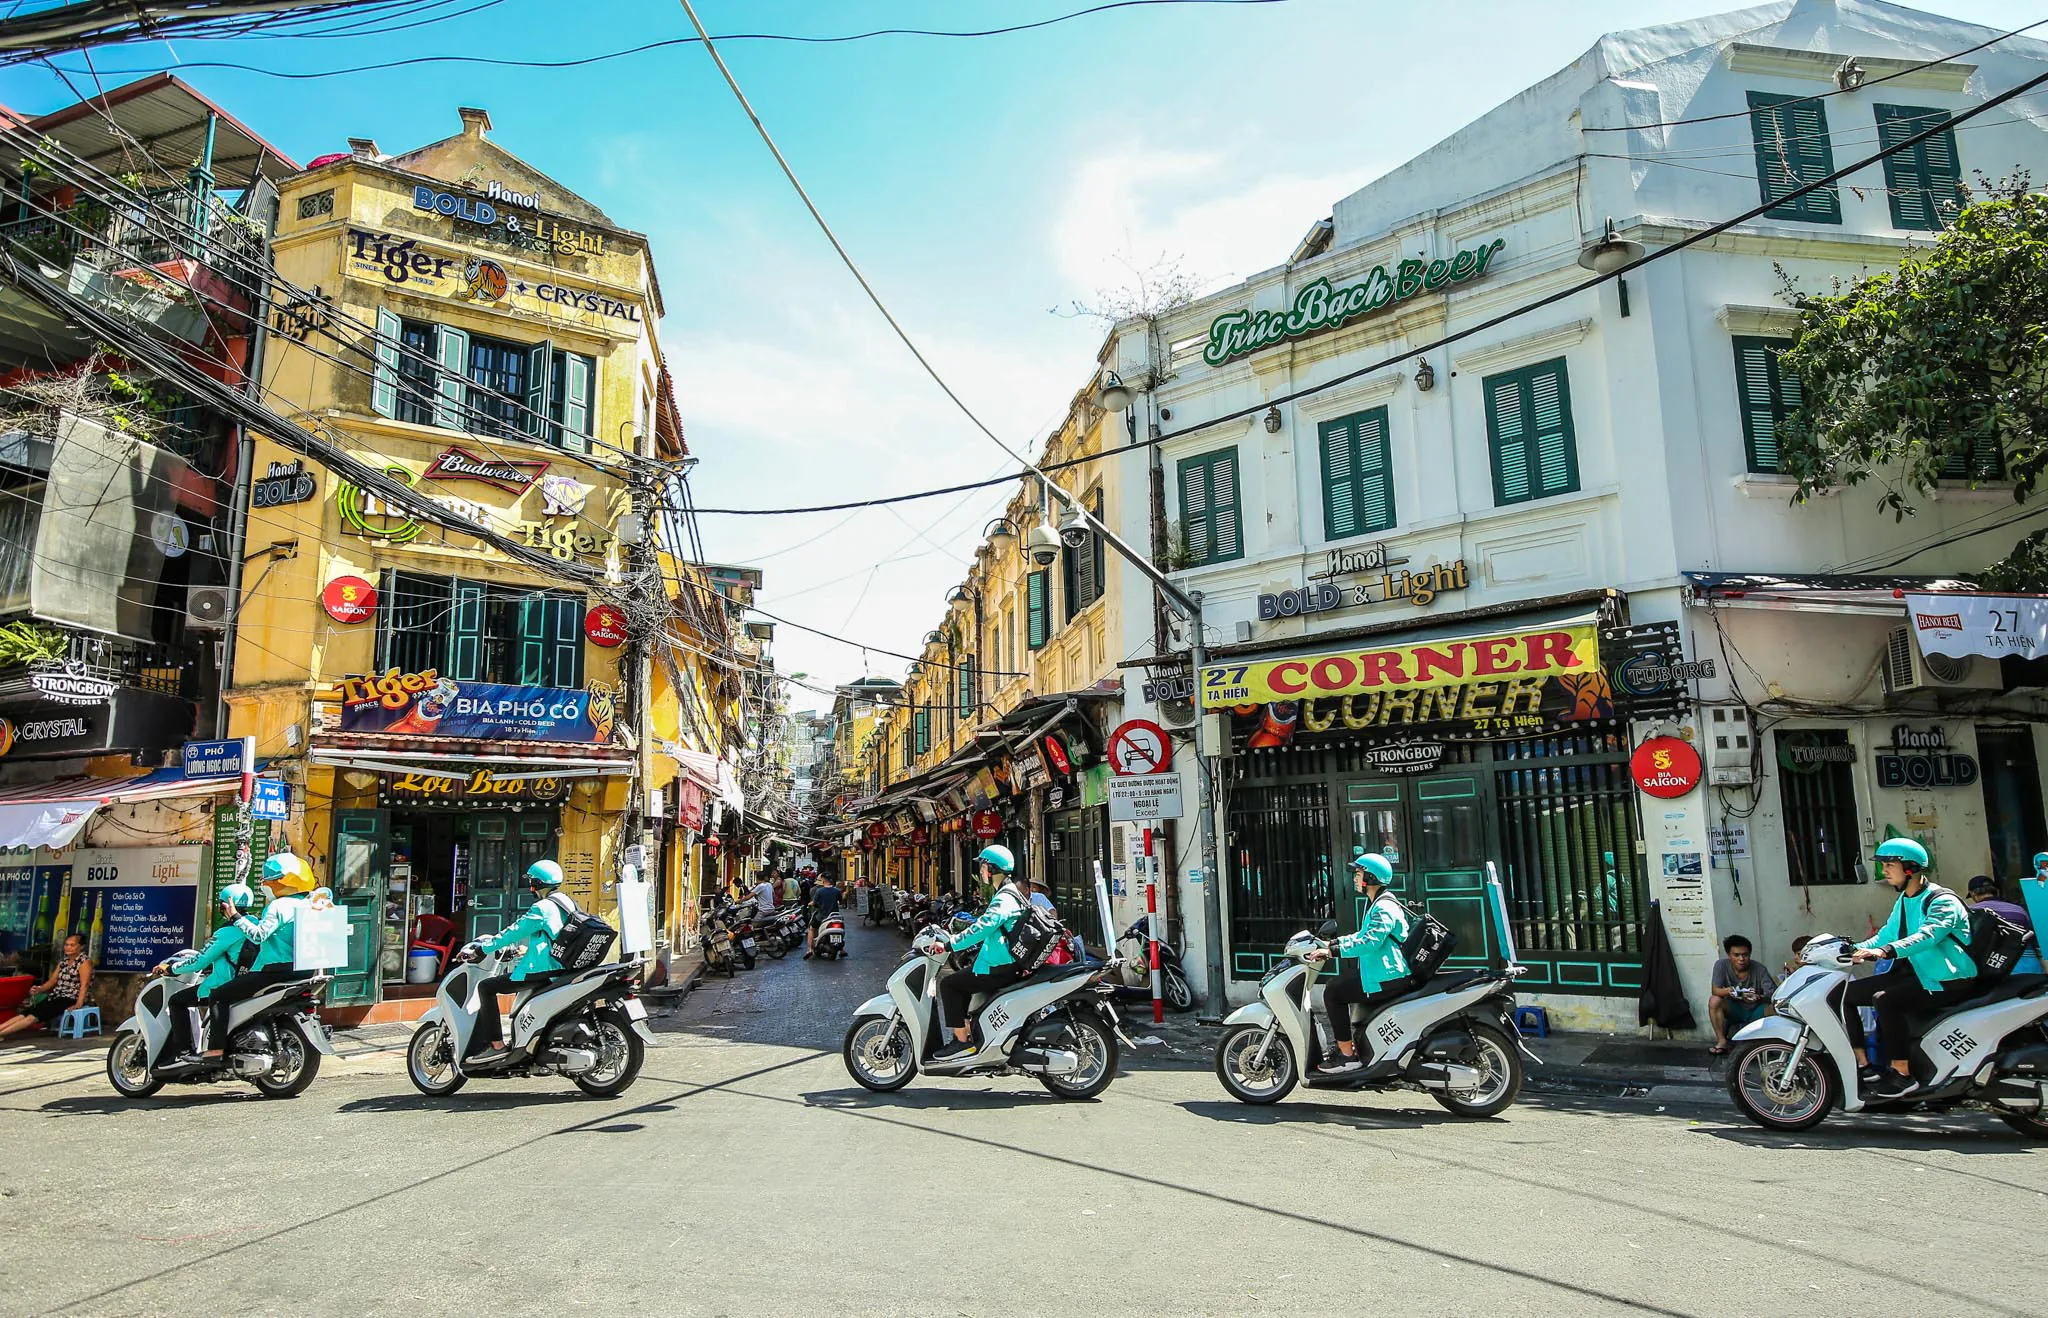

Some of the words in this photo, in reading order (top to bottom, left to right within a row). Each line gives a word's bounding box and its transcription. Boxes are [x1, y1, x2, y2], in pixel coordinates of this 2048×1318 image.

[487, 180, 541, 211] Hanoi
[413, 185, 498, 226] BOLD
[506, 214, 523, 234] &
[536, 217, 605, 257] Light
[349, 228, 453, 283] Tiger
[354, 261, 379, 273] SINCE
[1395, 238, 1506, 299] Beer
[535, 283, 642, 324] CRYSTAL
[267, 459, 300, 480] Hanoi
[437, 453, 534, 485] Budweiser
[252, 475, 314, 509] BOLD
[519, 518, 612, 561] Tiger
[1327, 547, 1386, 576] Hanoi
[1257, 583, 1342, 621] BOLD
[1382, 560, 1469, 606] Light
[1918, 614, 1942, 627] HANOI
[1942, 614, 1960, 628] BEER
[1989, 610, 2018, 633] 27
[1155, 664, 1184, 679] Hanoi
[1267, 631, 1583, 695] CORNER
[1628, 659, 1716, 685] TUBORG
[31, 676, 117, 697] STRONGBOW
[1206, 666, 1249, 687] 27
[333, 667, 438, 709] Tiger
[1142, 677, 1195, 705] BOLD
[1207, 689, 1222, 702] TẠ
[1224, 686, 1249, 700] HIỆN
[456, 698, 493, 715] BIA
[498, 697, 546, 717] PHỐ
[22, 718, 87, 740] CRYSTAL
[1474, 718, 1489, 730] 27
[1493, 717, 1510, 730] Tạ
[1899, 727, 1945, 748] Hanoi
[204, 744, 224, 756] PHỐ
[1366, 745, 1443, 764] STRONGBOW
[1380, 765, 1403, 774] APPLE
[1406, 763, 1434, 772] CIDERS
[1881, 754, 1978, 787] BOLD
[1643, 776, 1687, 787] SAIGON
[255, 798, 267, 814] TẠ
[87, 867, 119, 882] BOLD
[152, 864, 180, 884] Light
[1015, 941, 1028, 954] BAE
[520, 1013, 536, 1032] MIN
[987, 1004, 1005, 1023] BAE
[991, 1011, 1010, 1032] MIN
[1377, 1017, 1397, 1037] BAE
[1383, 1026, 1404, 1046] MIN
[1938, 1028, 1968, 1051] BAE
[1950, 1037, 1978, 1061] MIN
